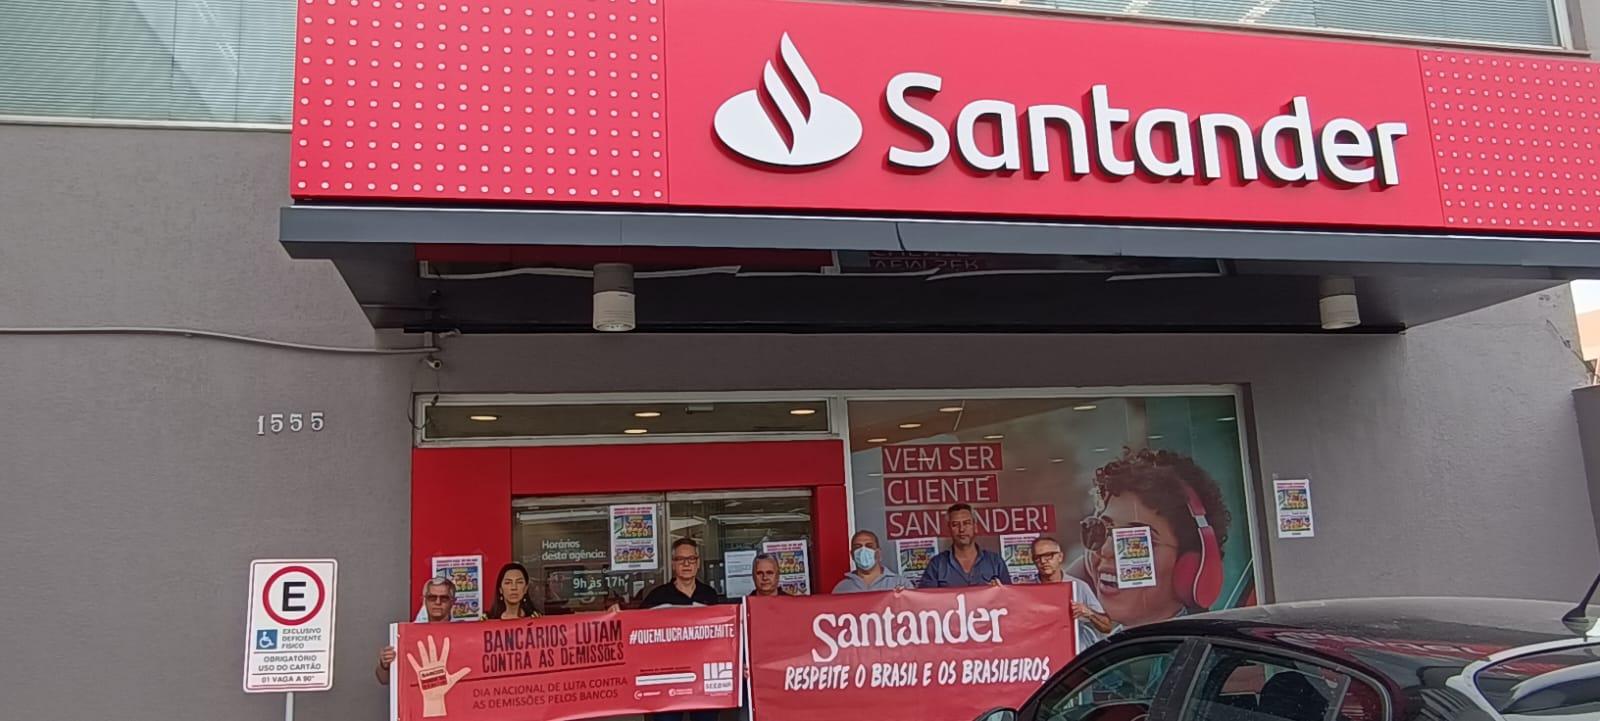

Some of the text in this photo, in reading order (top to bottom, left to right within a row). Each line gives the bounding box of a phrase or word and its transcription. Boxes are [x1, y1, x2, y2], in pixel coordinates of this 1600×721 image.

[886, 71, 1408, 187] Santander
[256, 412, 324, 435] 1555
[884, 446, 996, 472] VEM SER
[887, 477, 991, 504] CLIENTE
[889, 507, 1048, 537] SANNDER!
[542, 539, 580, 549] Horários
[542, 549, 607, 561] desta agência:
[282, 581, 306, 612] E
[573, 578, 587, 589] 9h
[282, 627, 322, 635] EXCLUSIVO
[483, 619, 623, 653] BANCÁRIOS LUTAM
[811, 593, 1008, 664] Santander
[289, 662, 322, 671] CARTÃO
[482, 642, 624, 674] CONTRA AS DEMISSÕES
[784, 656, 1050, 691] RESPEITE O BRASIL E OS BRASILEIROS
[472, 686, 491, 698] DIA
[493, 683, 545, 696] NACIONAL
[547, 682, 561, 692] DE
[563, 679, 587, 690] LUTA
[588, 676, 628, 689] CONTRA
[472, 689, 618, 710] AS DEMISSÕES PELOS BANCOS
